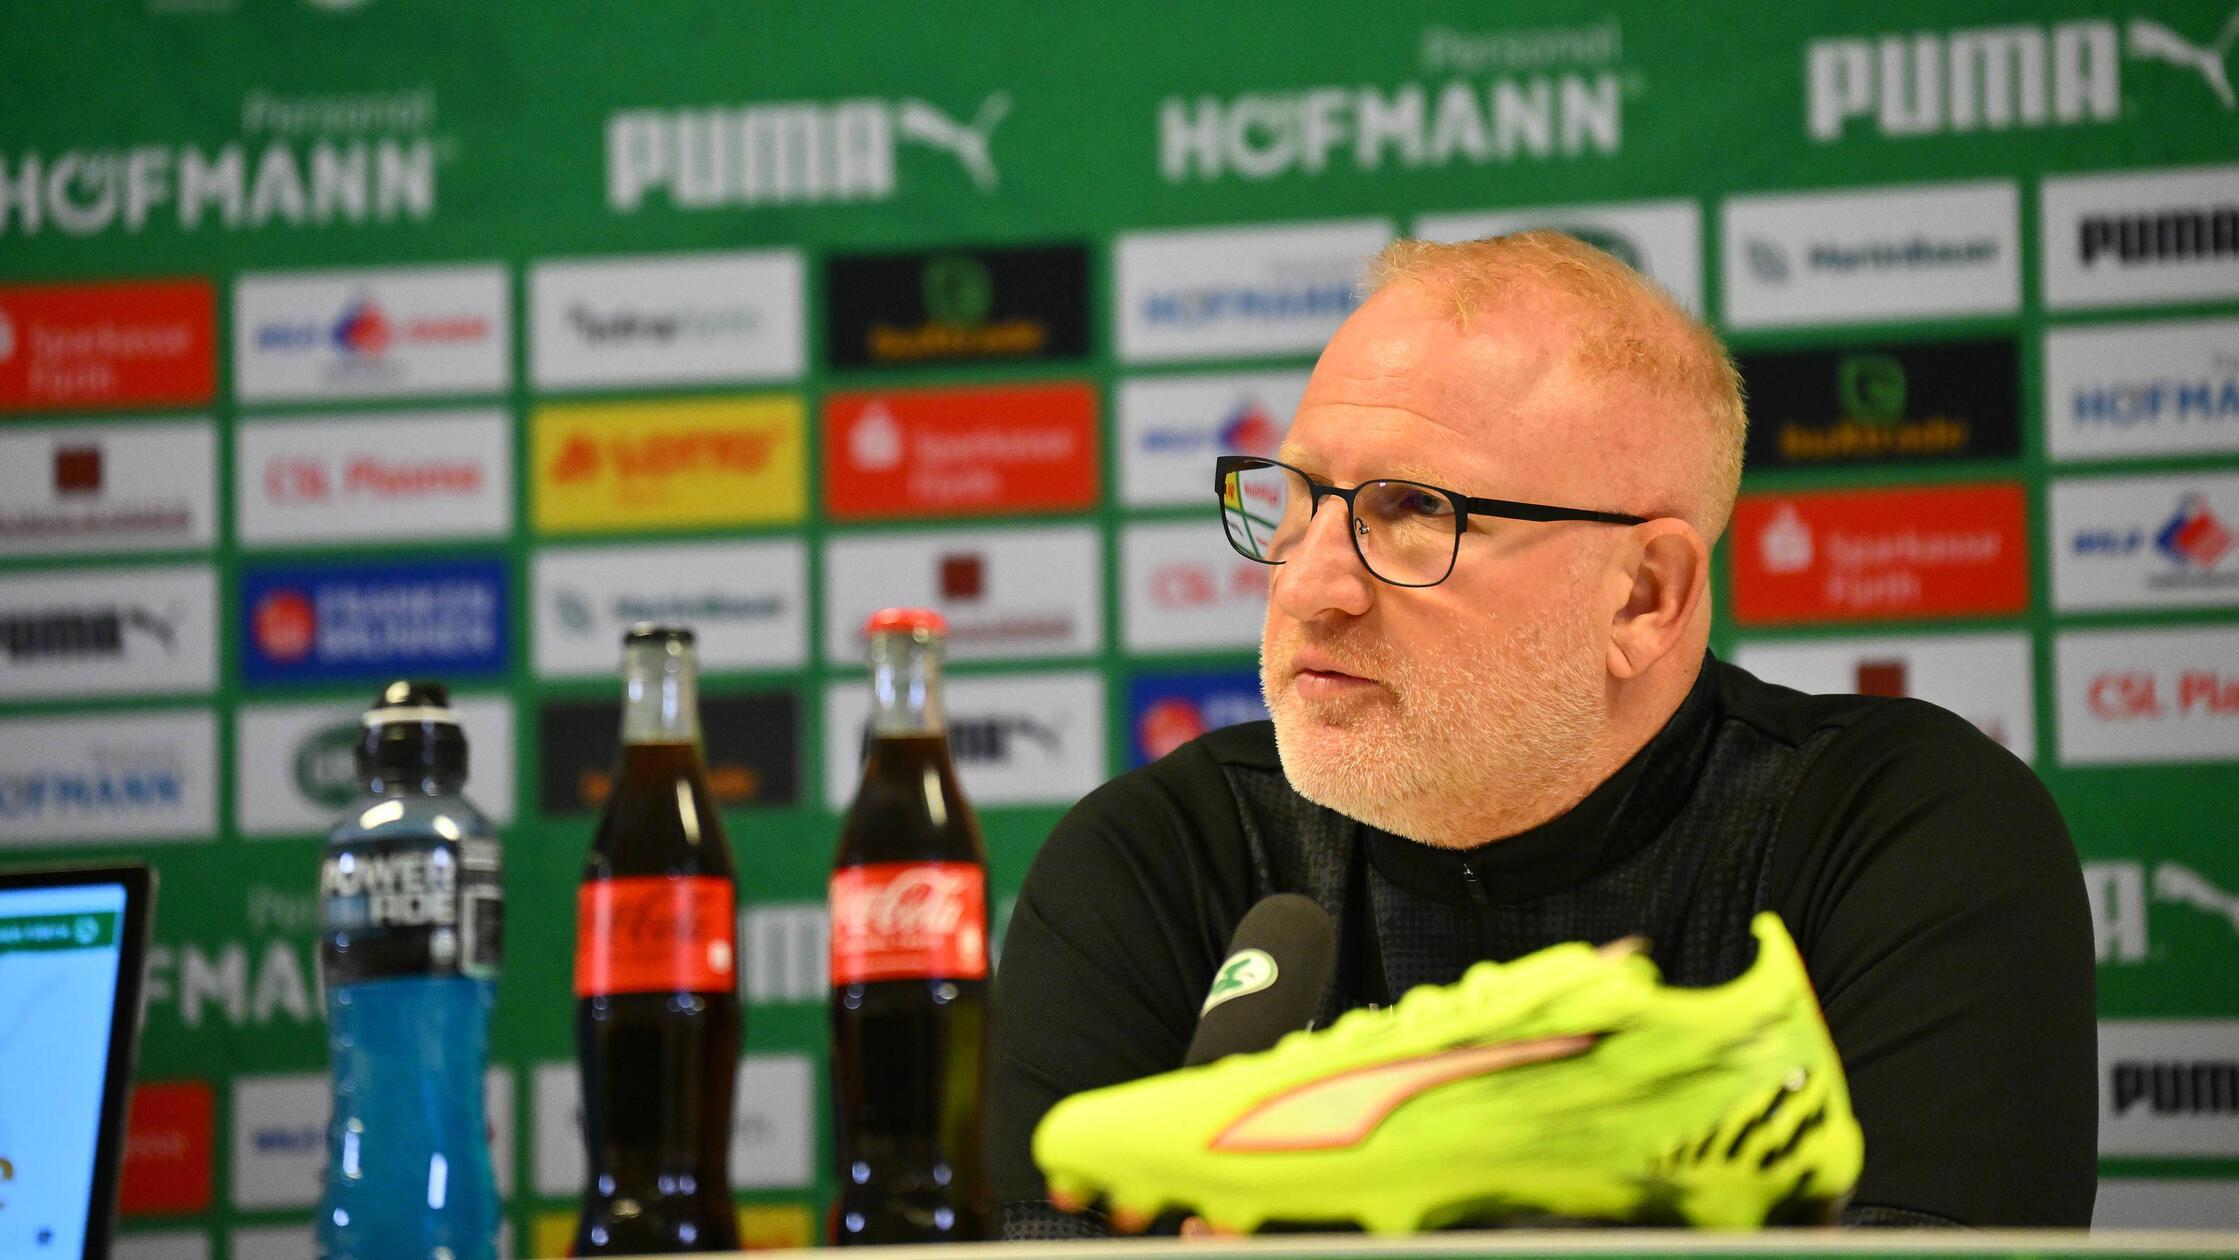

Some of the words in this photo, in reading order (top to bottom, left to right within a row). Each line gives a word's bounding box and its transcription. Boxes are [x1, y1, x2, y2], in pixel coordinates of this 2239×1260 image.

[1809, 22, 2120, 142] PUMA
[609, 100, 893, 211] PUMA
[1159, 74, 1621, 181] HOFMANN
[2073, 376, 2239, 424] HOFMA
[2178, 668, 2239, 716] Pla
[2111, 1060, 2239, 1117] PUM
